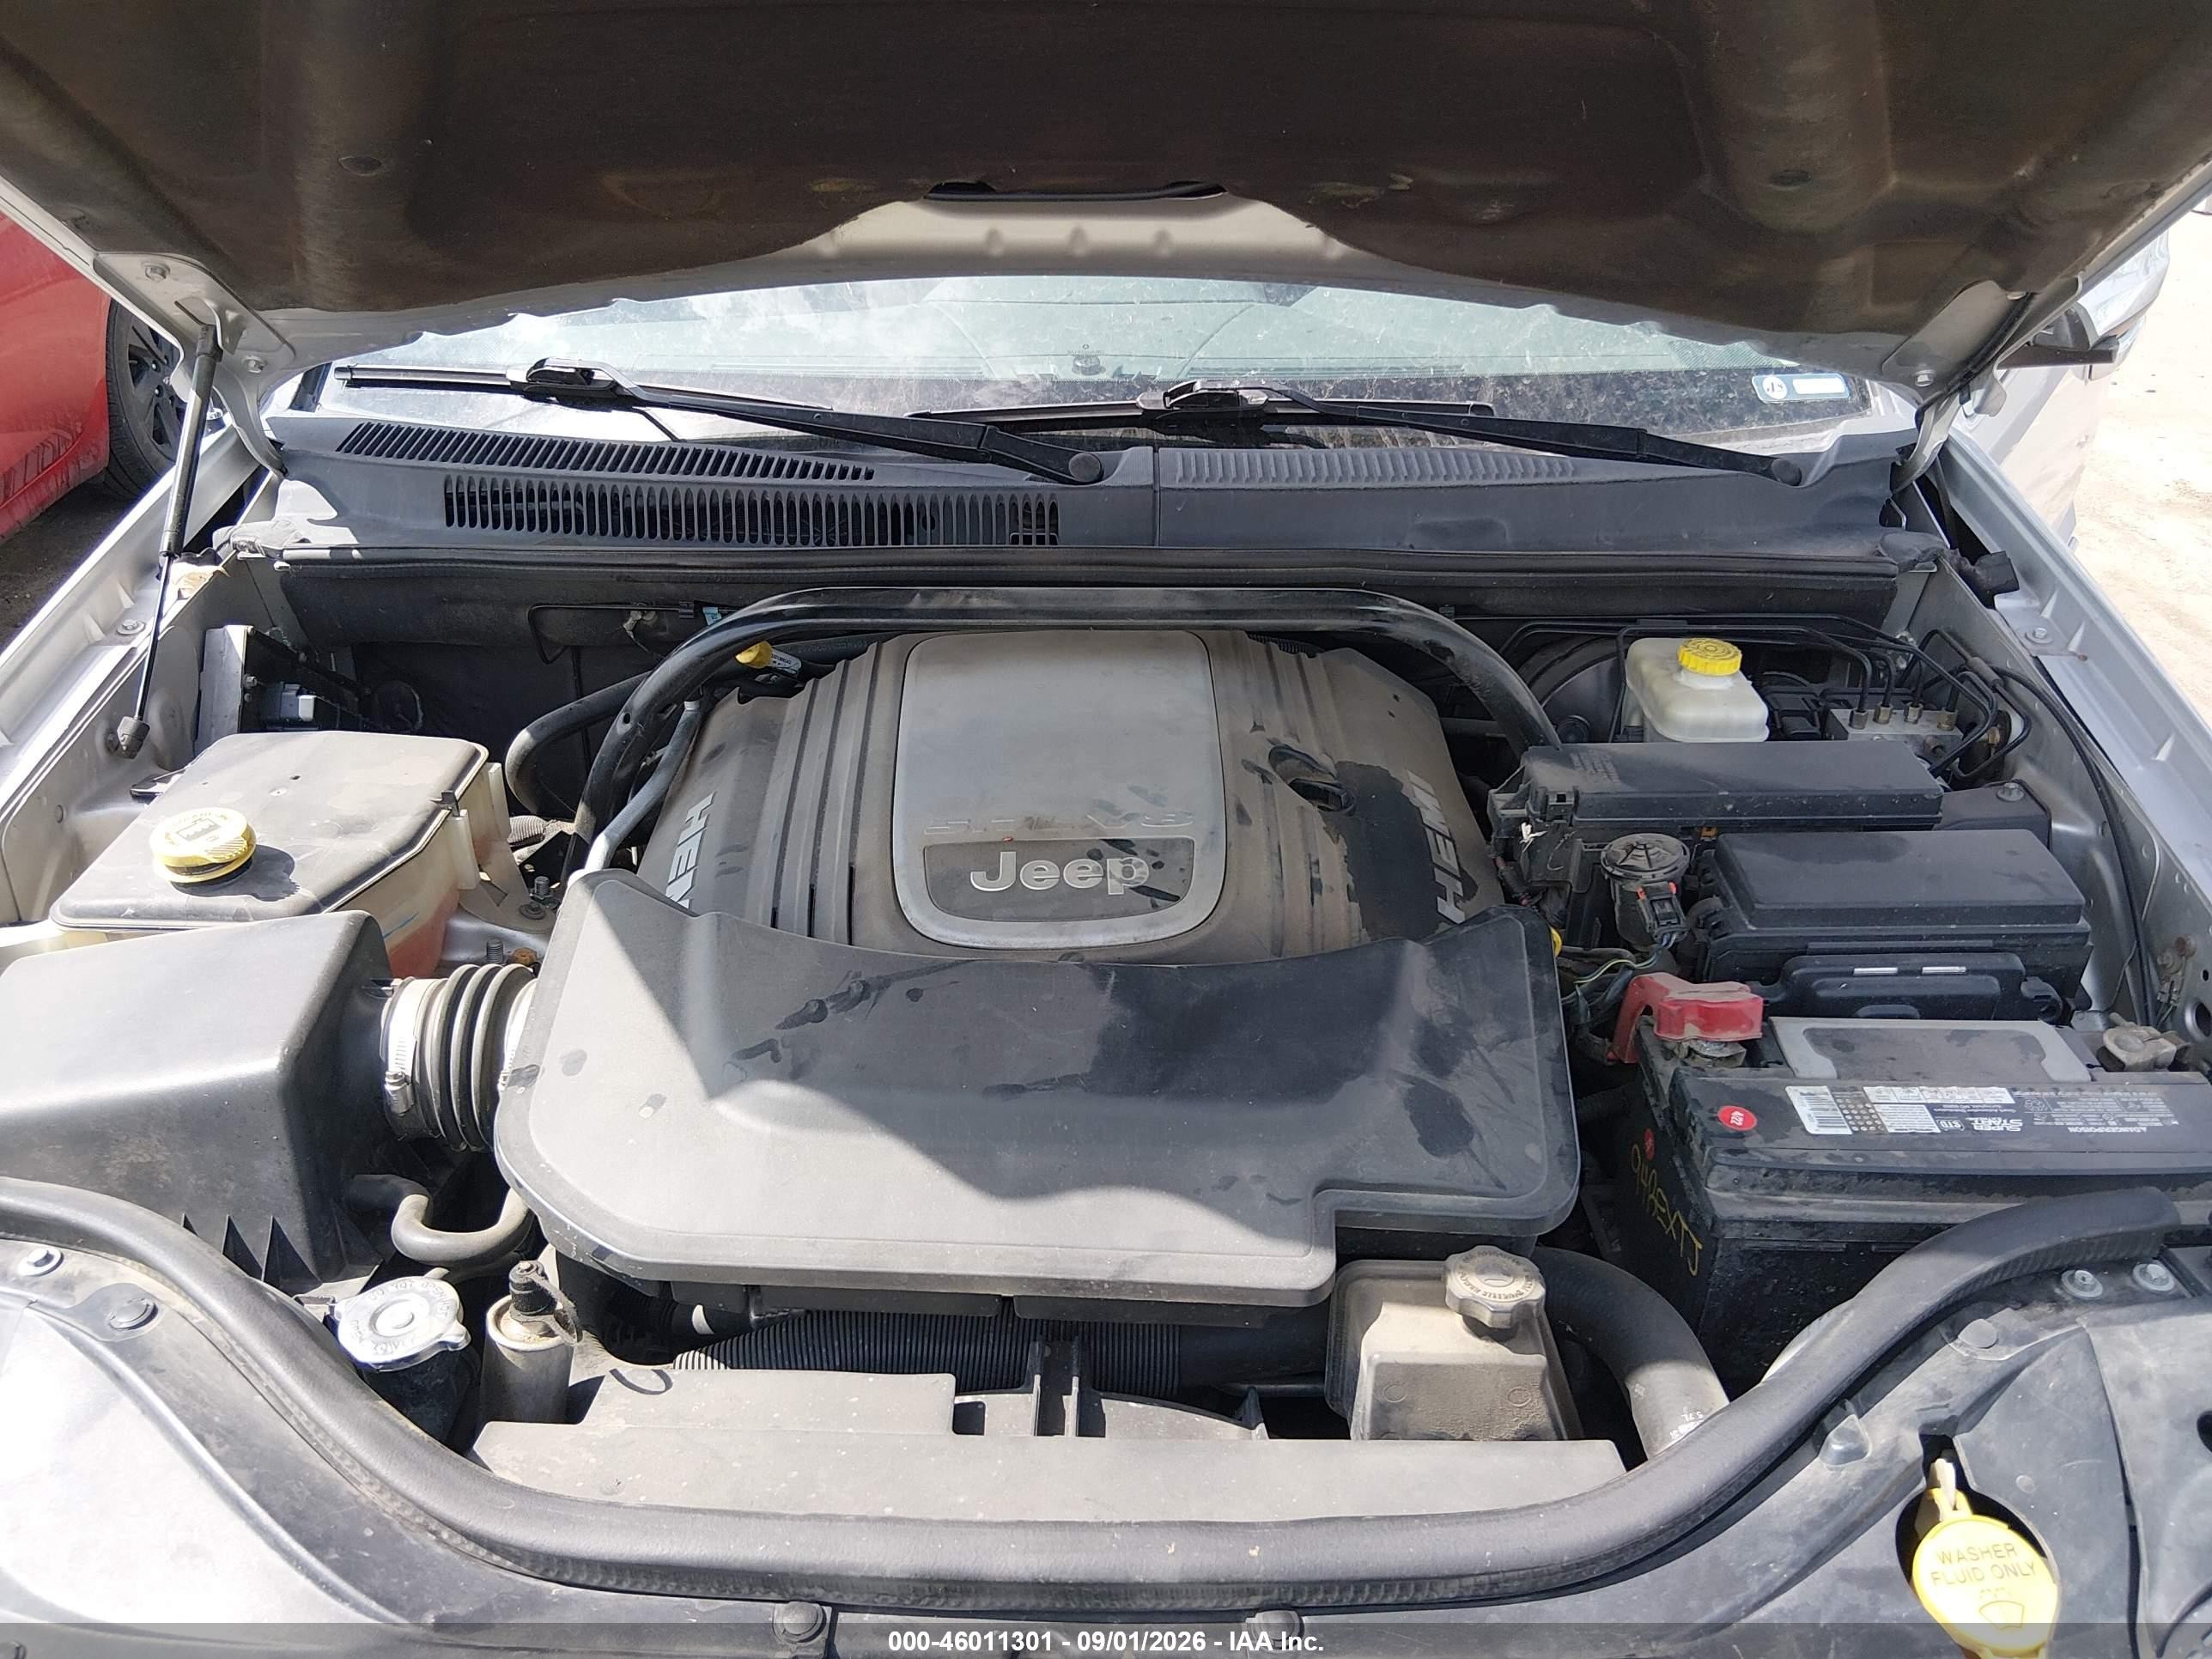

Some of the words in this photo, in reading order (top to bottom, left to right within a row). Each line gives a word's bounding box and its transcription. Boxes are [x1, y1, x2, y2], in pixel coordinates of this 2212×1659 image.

[1086, 810, 1195, 830] V8
[969, 851, 1151, 895] Jeep
[1936, 1542, 2018, 1565] WASHER
[1930, 1566, 1985, 1586] FLUID
[1990, 1561, 2036, 1580] ONLY
